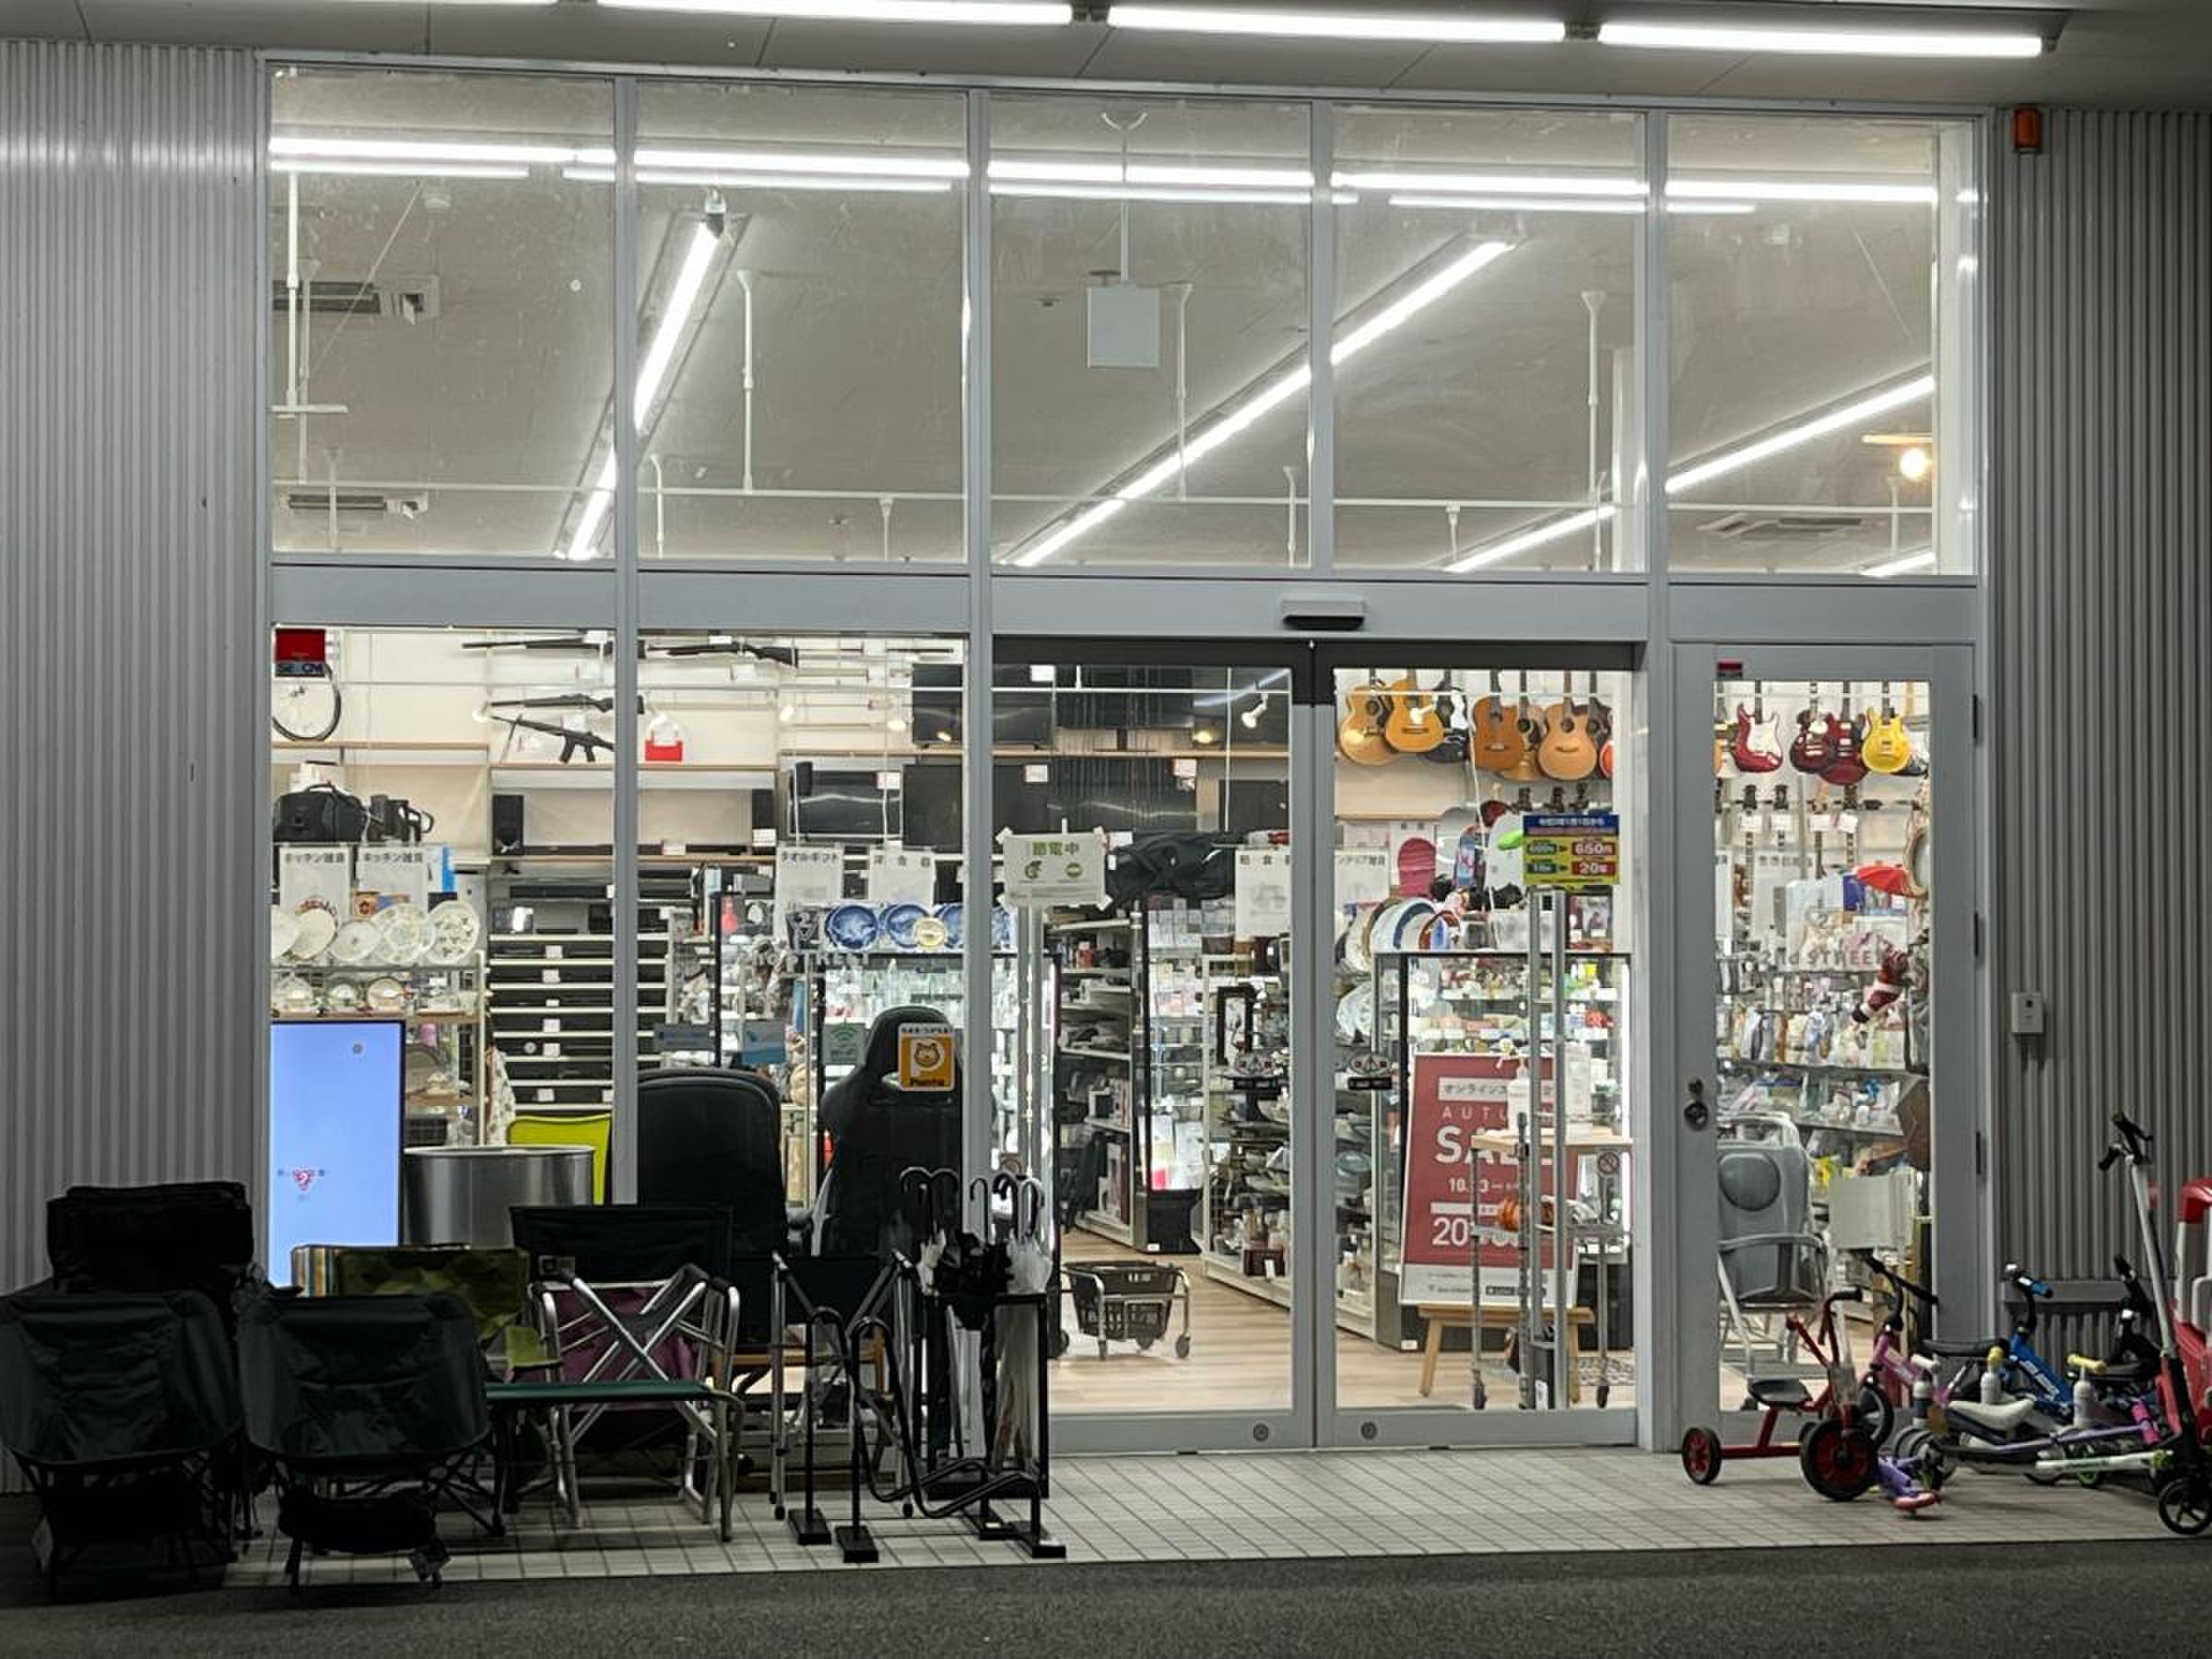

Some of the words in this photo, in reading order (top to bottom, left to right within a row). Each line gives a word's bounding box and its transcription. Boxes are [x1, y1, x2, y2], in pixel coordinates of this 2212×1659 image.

[1032, 841, 1079, 856] 節電中
[1441, 1106, 1509, 1120] AUTU
